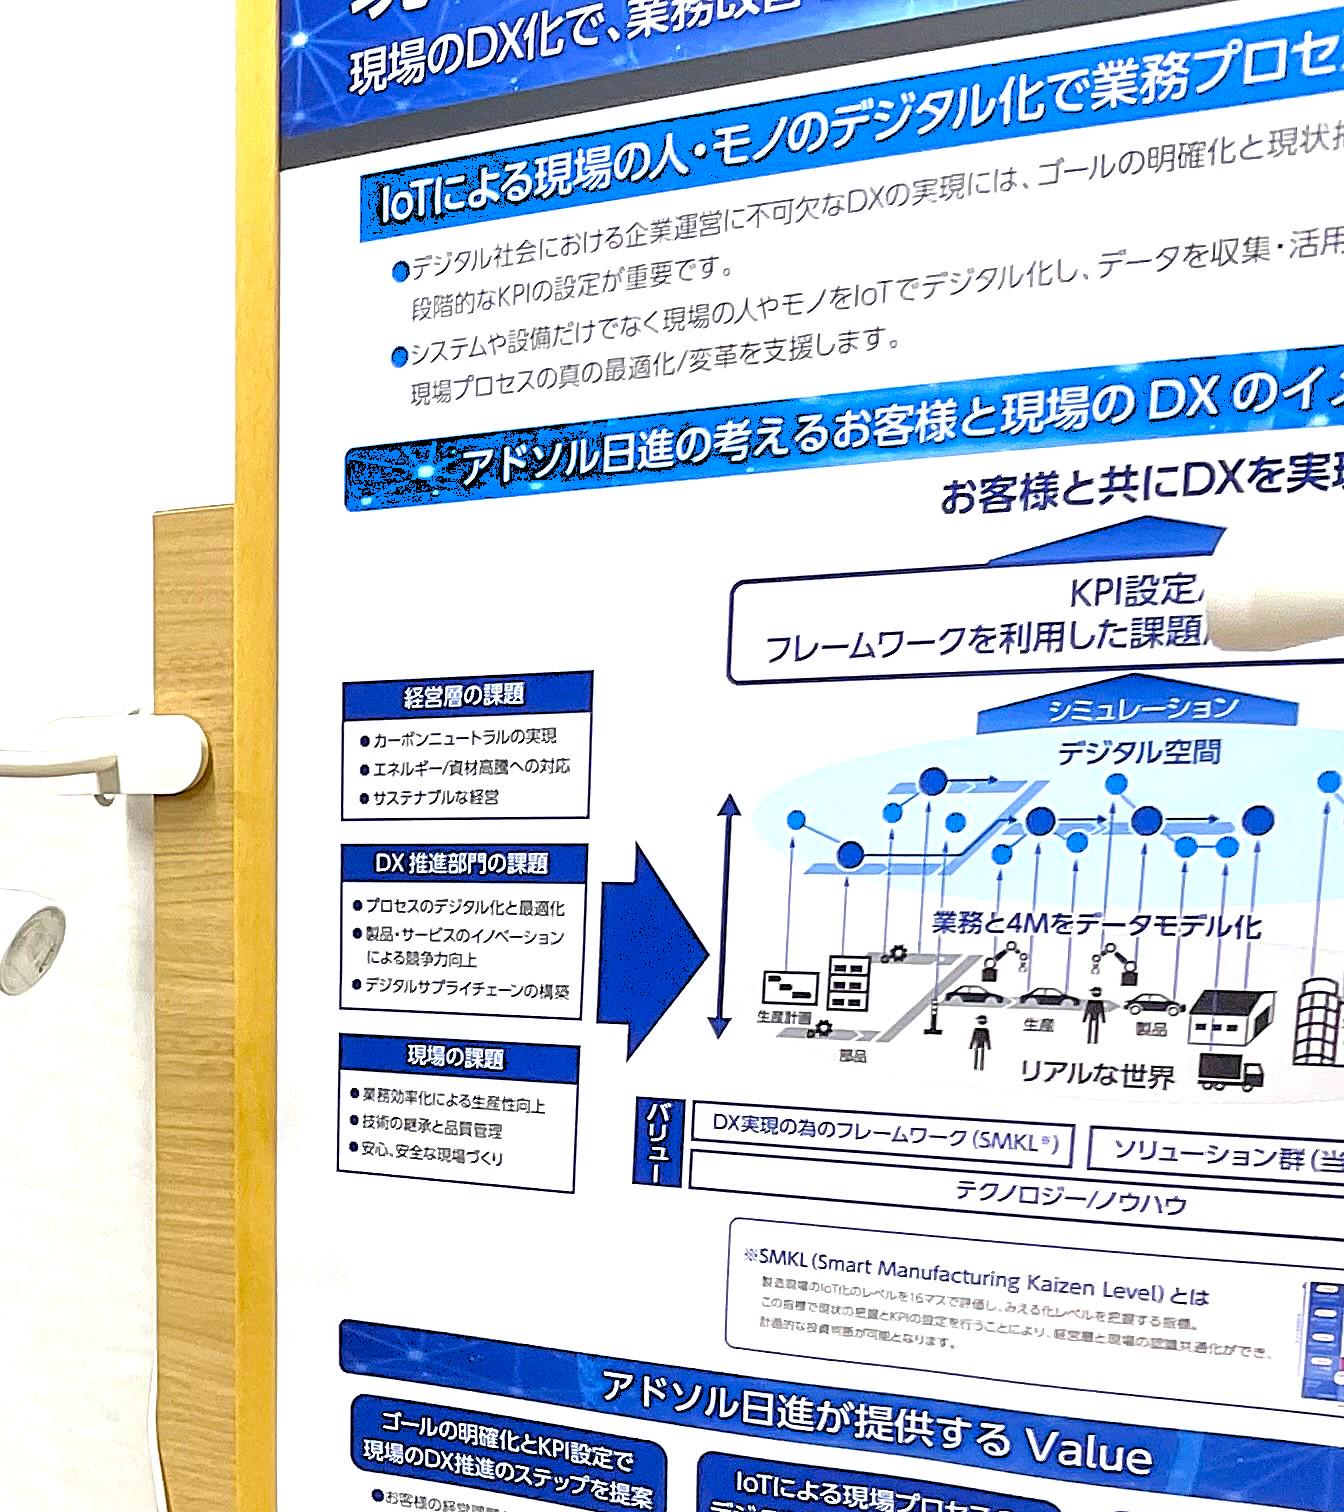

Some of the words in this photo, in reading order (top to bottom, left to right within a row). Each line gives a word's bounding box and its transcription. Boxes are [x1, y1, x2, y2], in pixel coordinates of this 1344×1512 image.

[380, 28, 1344, 225] IoTによる現場の人・モノのデジタル化で業務プロセ
[412, 255, 733, 322] 段階的なKPIの設定が重要です。
[1148, 376, 1222, 422] DX
[1070, 572, 1205, 608] KPI設定
[765, 614, 1209, 664] フレームワークを利用した課題
[403, 681, 526, 710] 経営層の課題
[1047, 696, 1240, 723] シミュレーション
[373, 726, 558, 748] カーボンニュートラルの実現
[1058, 738, 1223, 767] デジタル空間
[373, 789, 500, 808] サステナブルな経営
[375, 853, 405, 873] DX
[409, 852, 550, 876] 推進部門の課題
[366, 899, 566, 918] プロセスのデジタル化と最適化
[366, 926, 565, 946] 製品・サービスのイノベーション
[932, 910, 1263, 941] 業務と4Mをデータモデル化
[367, 951, 478, 969] による競争力向上
[365, 977, 571, 1001] デジタルサプライチェーンの構築
[757, 1009, 813, 1026] 生産計画
[1023, 1018, 1055, 1034] 生産
[406, 1043, 506, 1071] 現場の課題
[1020, 1060, 1176, 1092] リアルな世界
[362, 1087, 547, 1115] 業務効率化による生産性向上
[362, 1115, 504, 1140] 技術の継承と品質管理
[361, 1141, 504, 1167] 安心、安全な現場づくり
[645, 1101, 672, 1184] バリュー
[1113, 1138, 1306, 1171] ソリューション群
[955, 1180, 1188, 1216] テクノロジー/ノウハウ
[878, 1260, 1021, 1294] Manufacturing
[1026, 1273, 1095, 1297] Kaizen
[1170, 1287, 1210, 1307] とは
[601, 1369, 1012, 1459] アドソル日進が提供する
[1025, 1426, 1155, 1479] Value
[381, 1409, 634, 1474] ゴールの明確化とKPI設定で
[363, 1438, 654, 1511] 現場のDX推進のステップを提案
